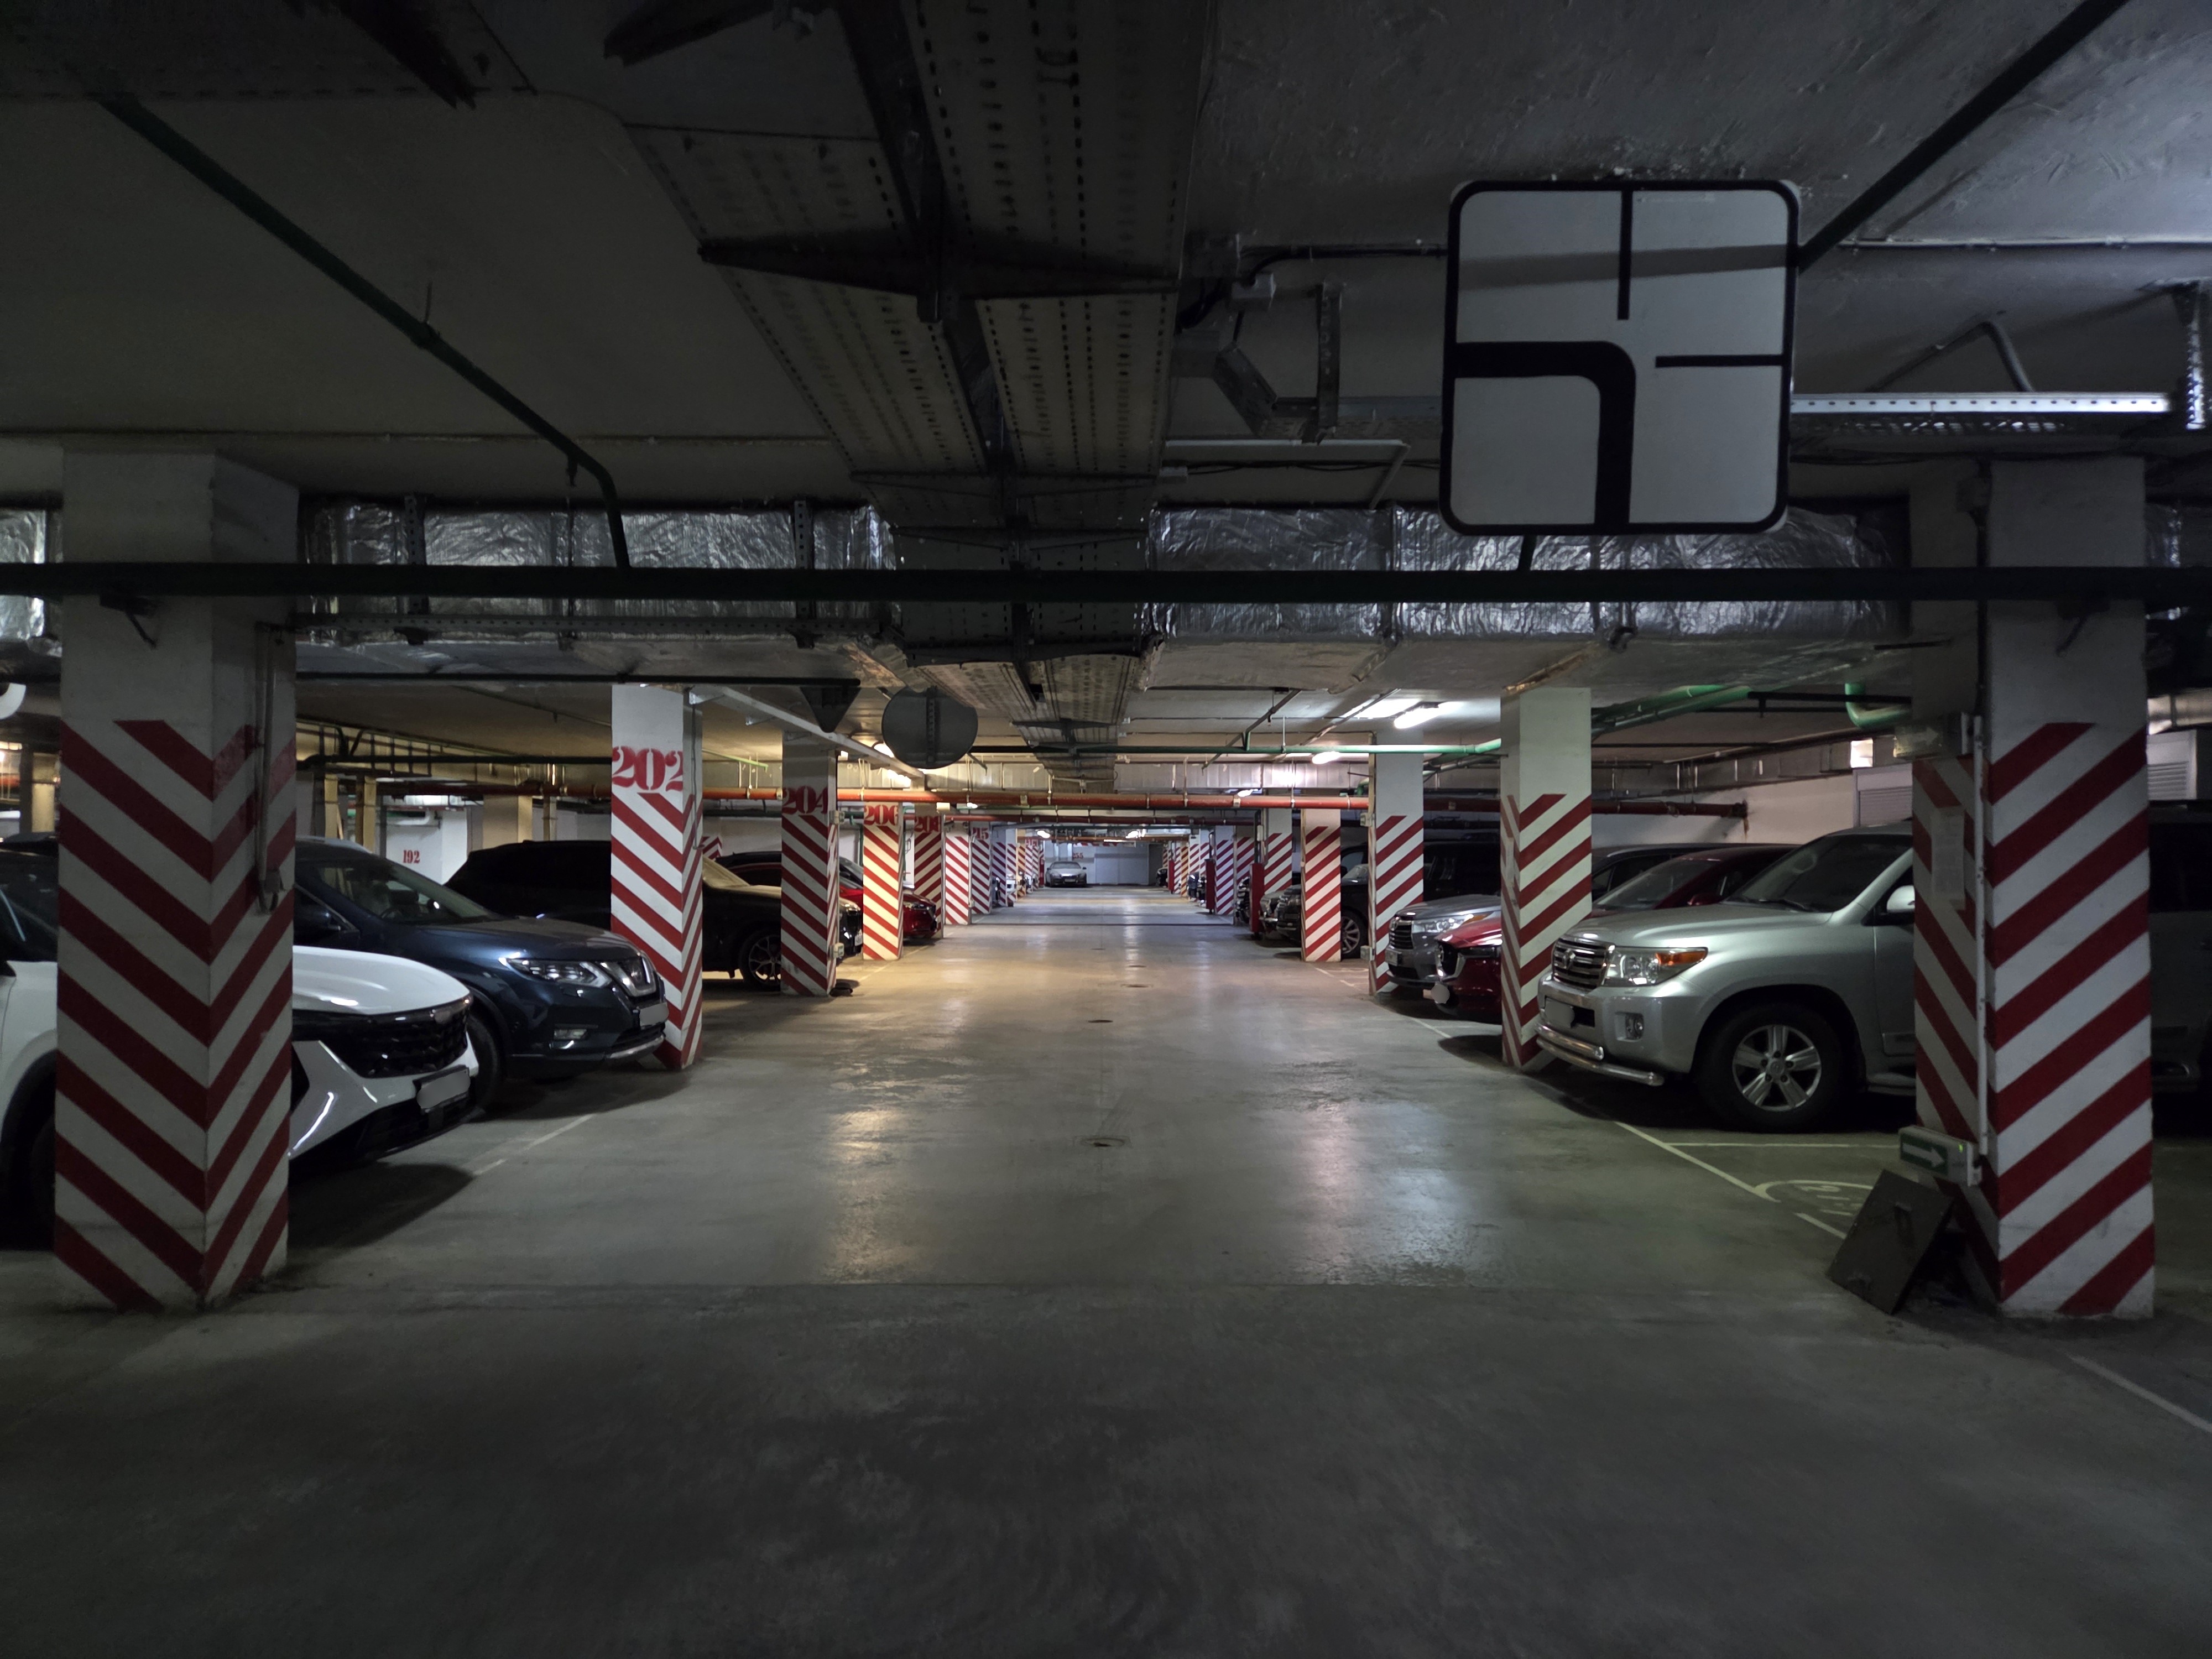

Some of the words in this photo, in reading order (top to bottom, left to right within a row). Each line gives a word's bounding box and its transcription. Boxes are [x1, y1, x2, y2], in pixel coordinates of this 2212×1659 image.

[612, 746, 683, 792] 202
[782, 785, 828, 815] 204
[403, 849, 420, 864] 192
